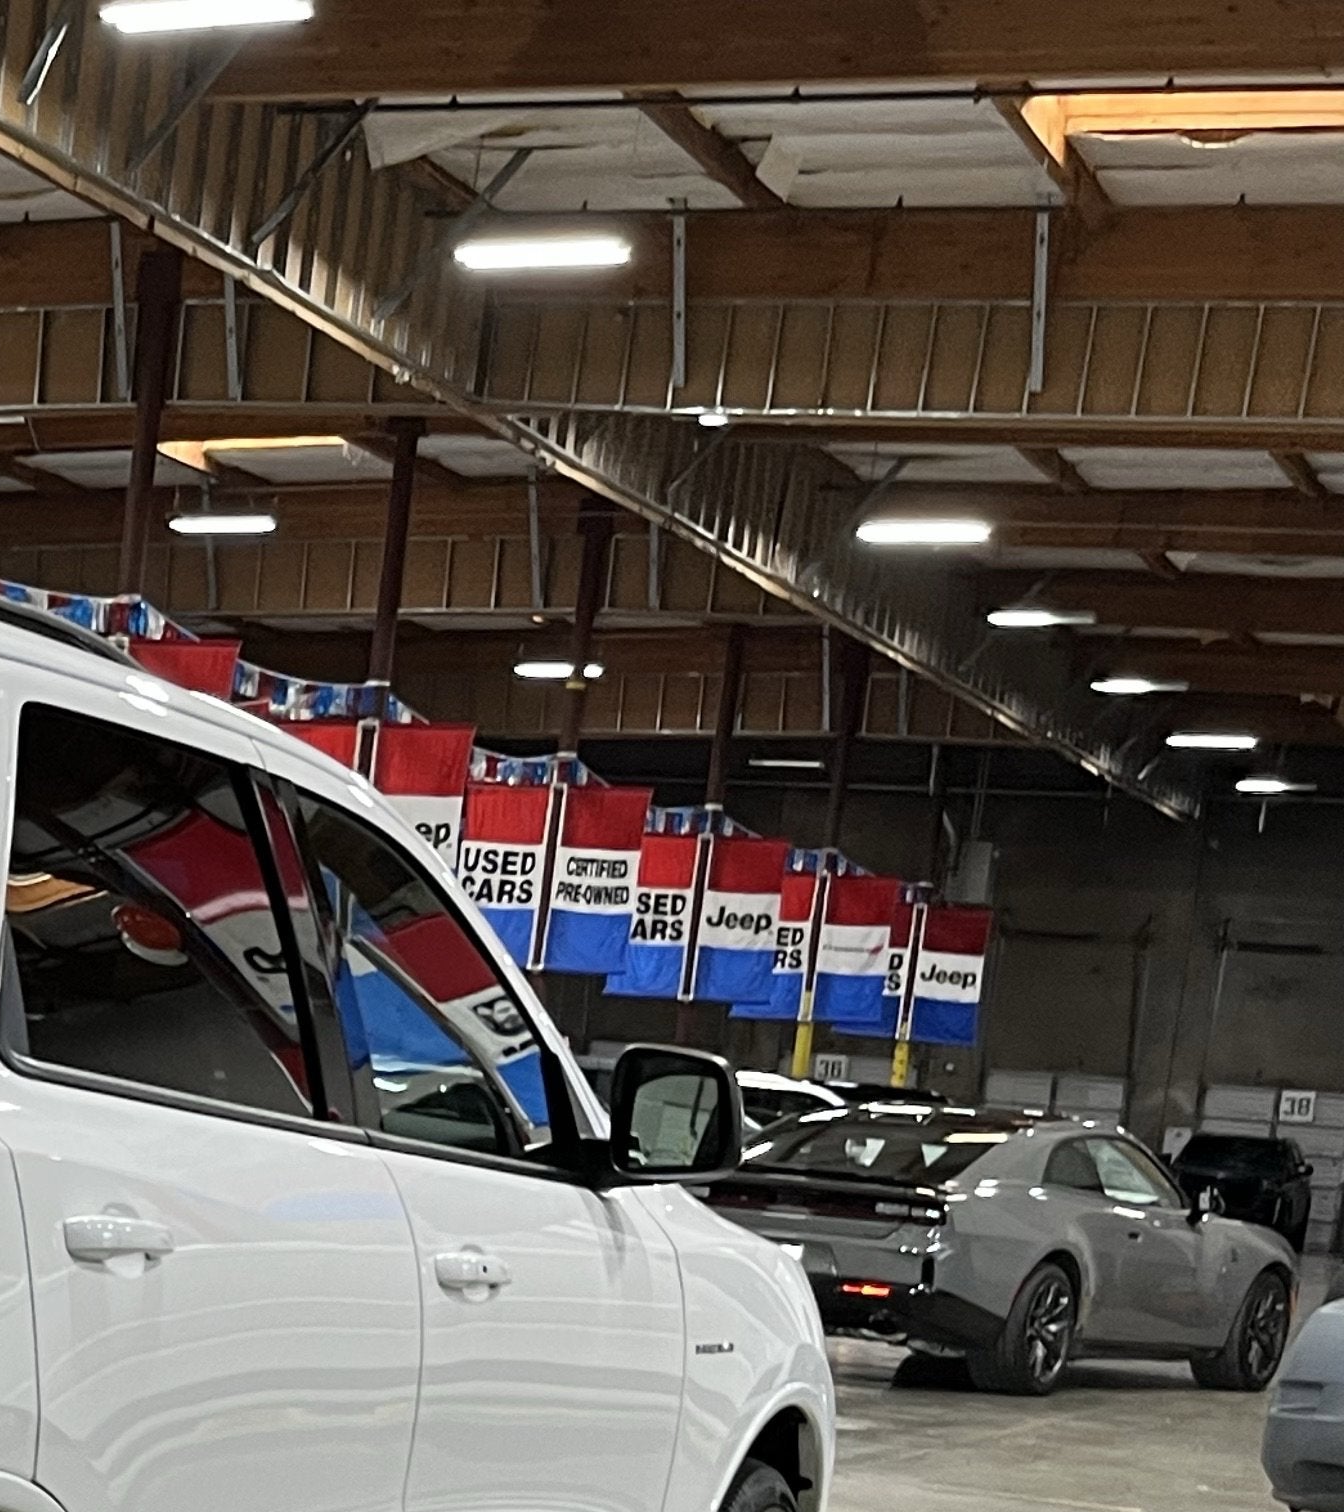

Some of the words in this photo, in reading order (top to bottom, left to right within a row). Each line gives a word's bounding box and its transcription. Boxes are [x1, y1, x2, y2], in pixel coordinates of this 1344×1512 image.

[415, 822, 451, 849] ep
[464, 847, 536, 876] USED
[566, 856, 628, 879] CERTIFIED
[462, 876, 533, 904] CARS
[555, 881, 630, 905] PRE-OWNED
[635, 892, 687, 916] SED
[630, 918, 684, 941] ARS
[706, 906, 772, 935] Jeep
[776, 926, 804, 947] ED
[773, 949, 803, 969] RS
[920, 964, 977, 990] Jeep
